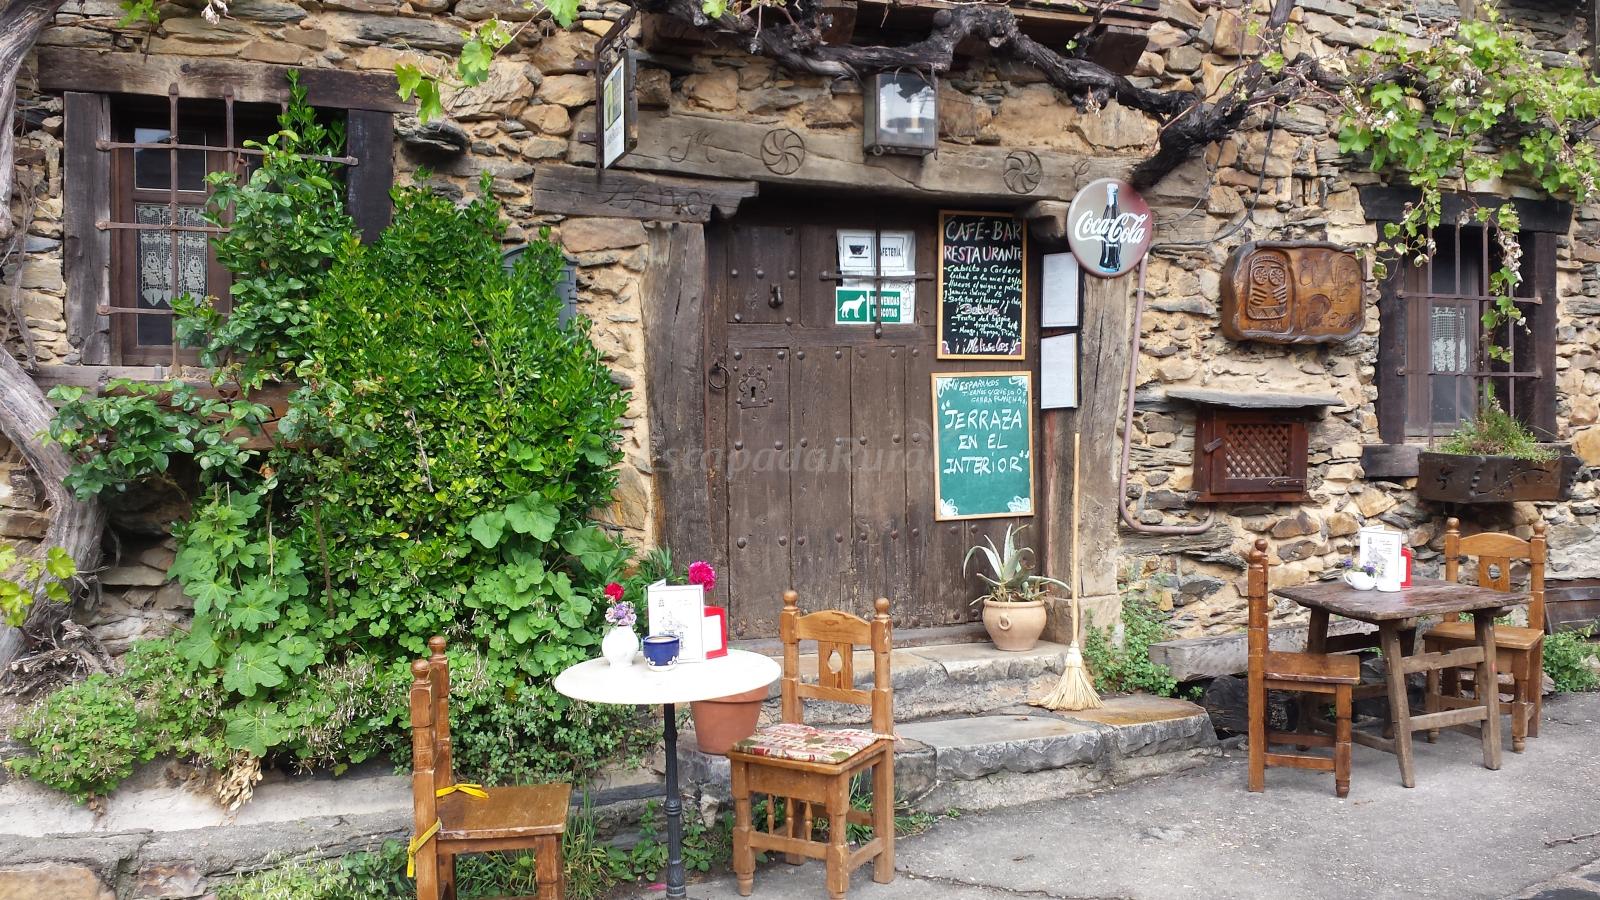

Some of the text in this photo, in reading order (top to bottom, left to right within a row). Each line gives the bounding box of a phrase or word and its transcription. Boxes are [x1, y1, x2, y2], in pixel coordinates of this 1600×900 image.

[946, 217, 1022, 242] CAFÉ-BAR
[1075, 210, 1148, 244] Coca-Cola
[944, 244, 1023, 264] RESTAURANTE
[958, 433, 1008, 450] EN EL
